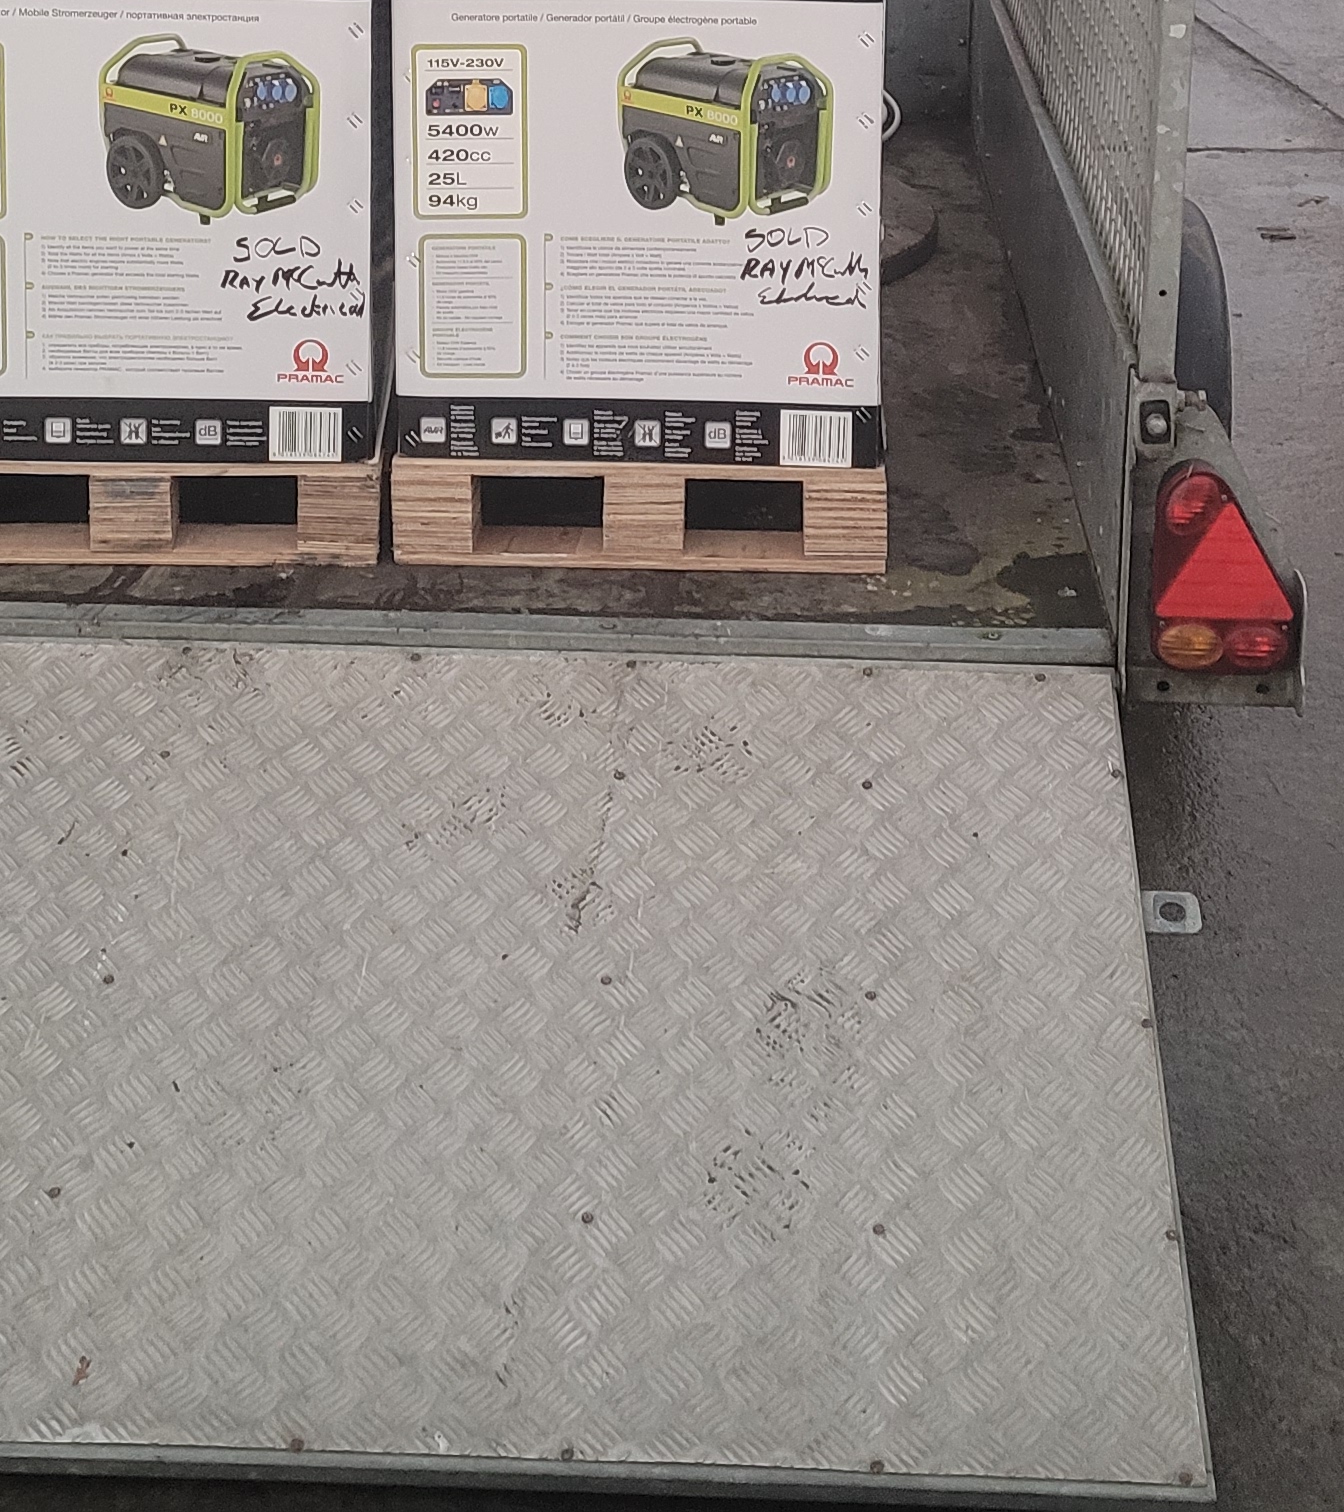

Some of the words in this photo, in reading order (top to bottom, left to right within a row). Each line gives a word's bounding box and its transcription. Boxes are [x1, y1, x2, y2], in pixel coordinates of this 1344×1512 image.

[18, 7, 50, 18] Mobile
[51, 8, 118, 20] Stromerzeuger
[450, 12, 501, 23] Generatore
[501, 13, 538, 24] portatile
[545, 12, 593, 23] Generador
[632, 14, 666, 25] Groupe
[720, 16, 758, 26] portable
[426, 57, 504, 69] 115V-230V
[169, 103, 188, 117] PX
[190, 107, 224, 124] 8000
[685, 105, 704, 119] PX
[427, 148, 492, 163] 420cc
[427, 172, 468, 186] 25L
[427, 193, 479, 211] 94kg
[744, 227, 830, 252] SOLD
[233, 235, 321, 263] SOLD
[740, 257, 793, 283] RAY
[220, 269, 266, 294] RAY
[276, 372, 344, 384] PRAMAC
[787, 376, 854, 388] PRAMAC
[198, 423, 218, 438] dB
[708, 425, 728, 441] dB
